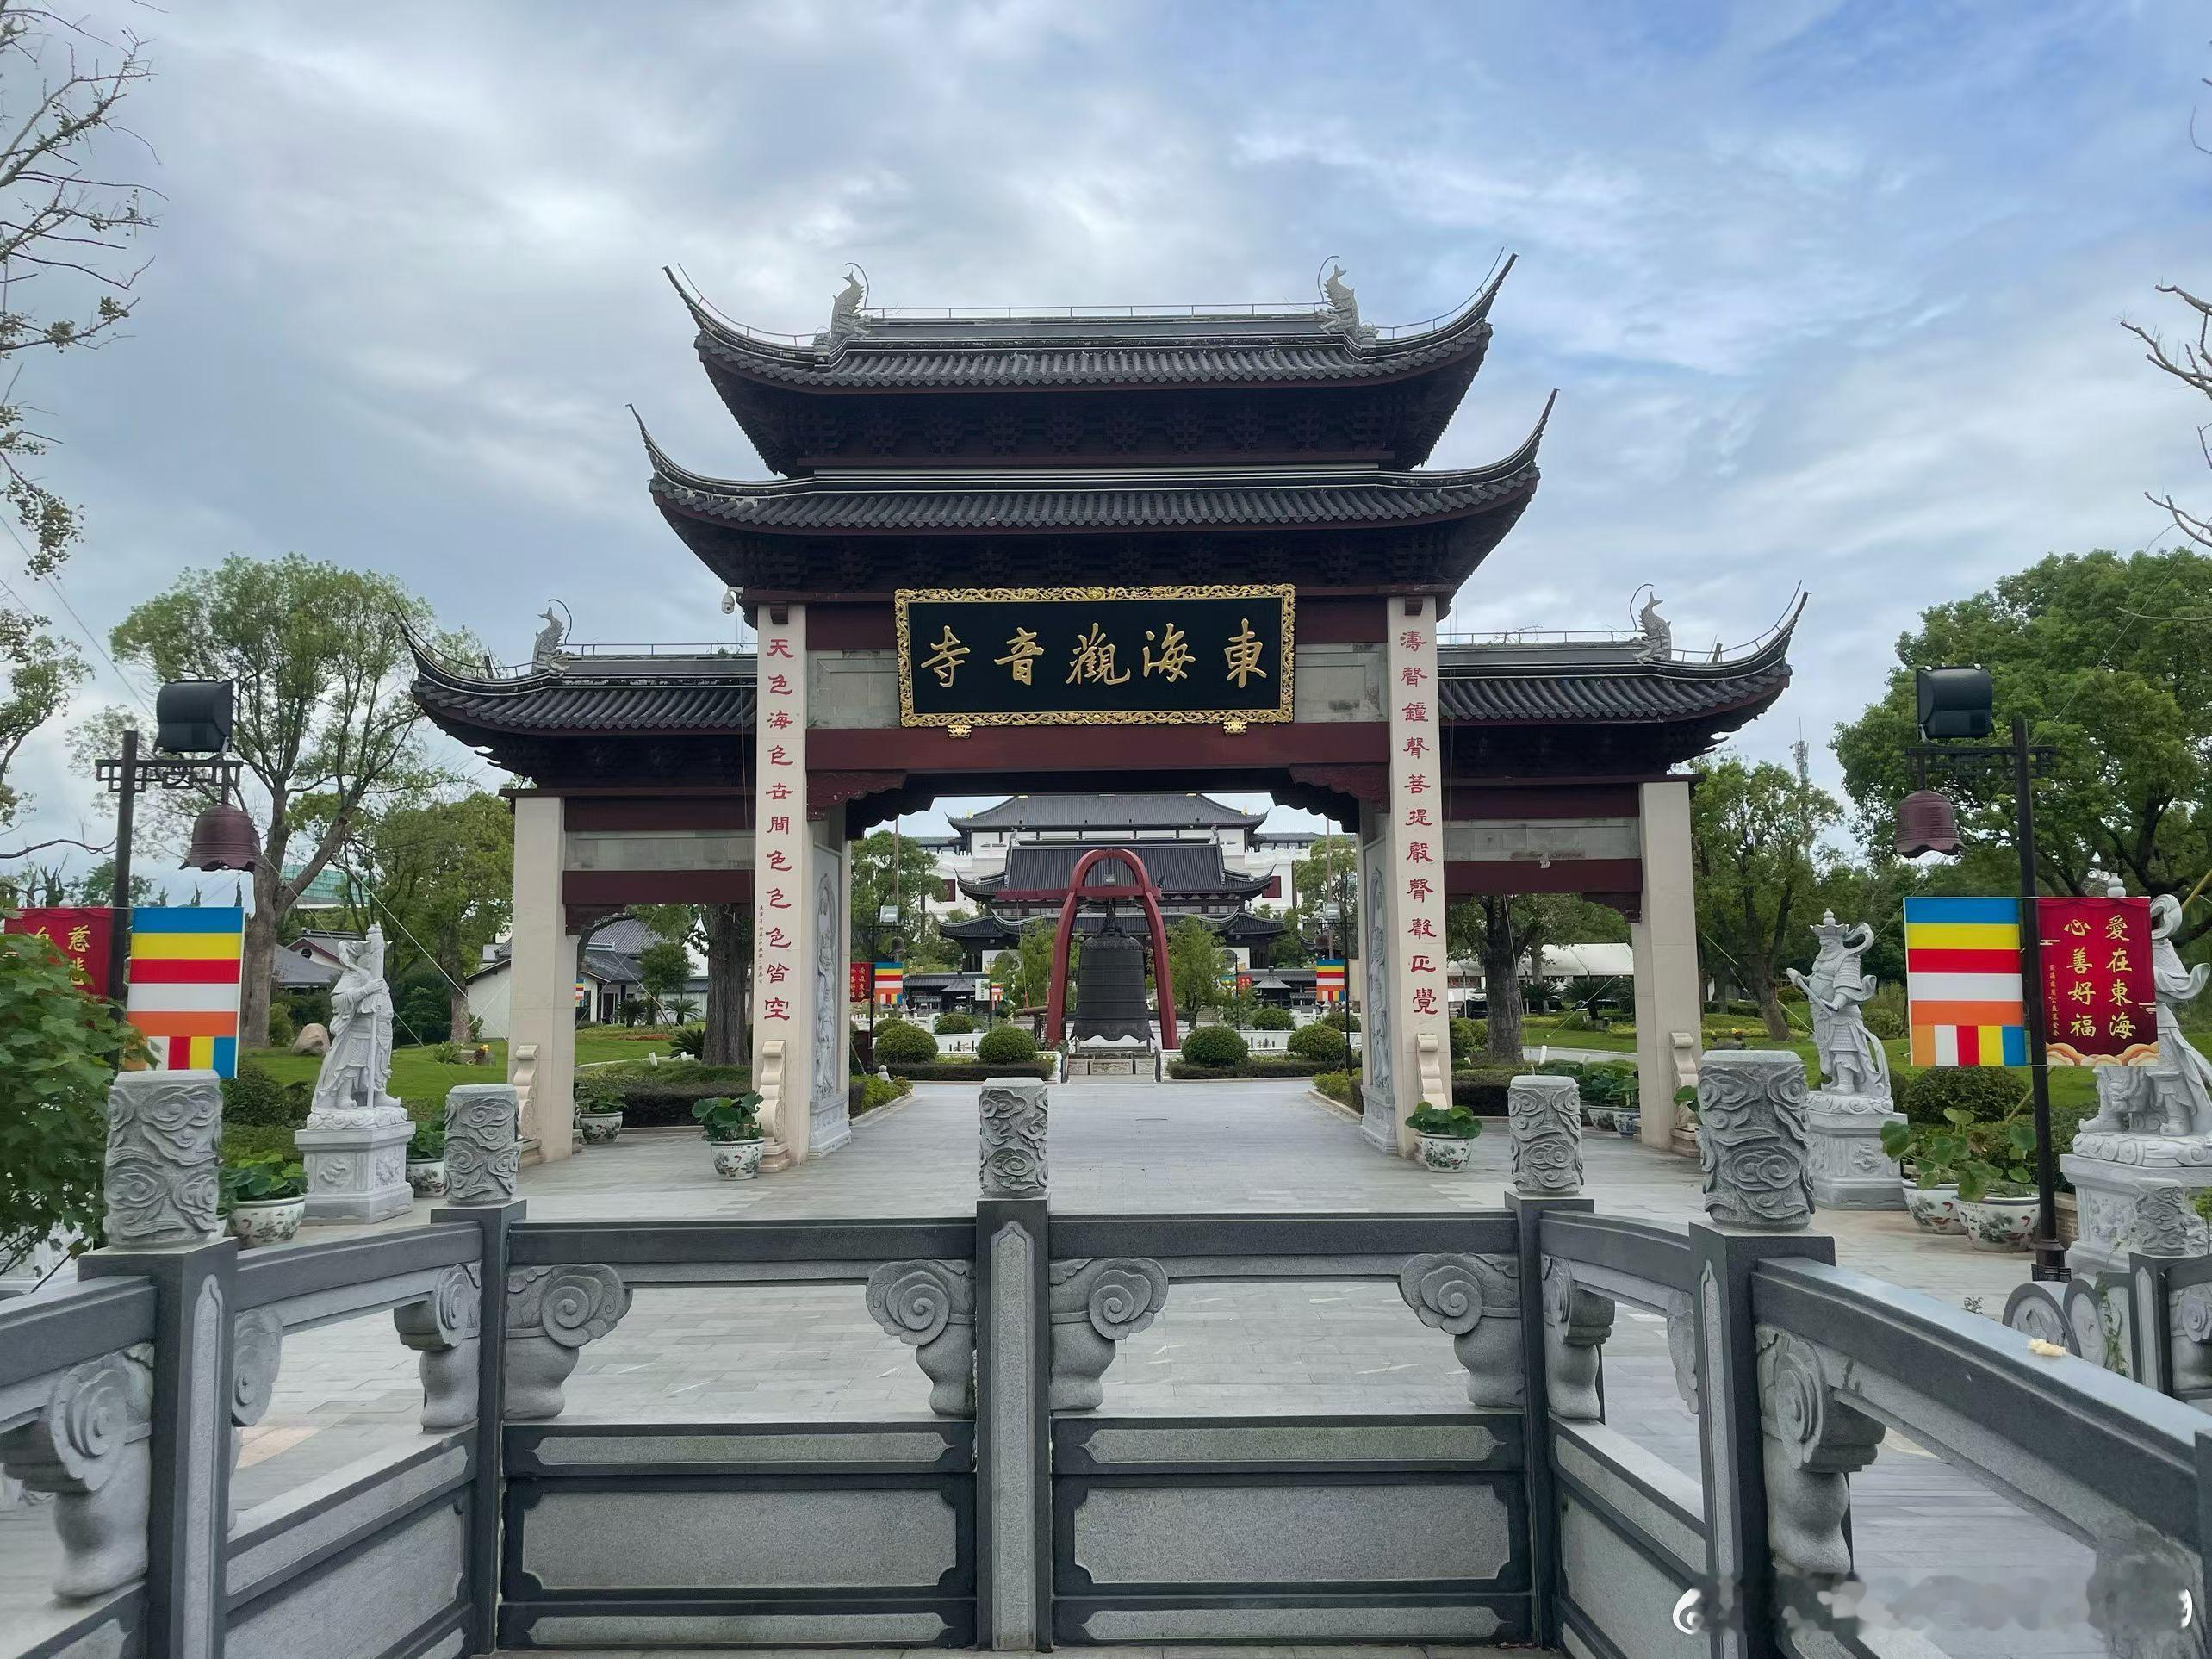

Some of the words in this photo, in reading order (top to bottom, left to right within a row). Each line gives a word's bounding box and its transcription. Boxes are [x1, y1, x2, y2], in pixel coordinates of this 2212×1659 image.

[920, 618, 1268, 688] 東海觀音寺
[2063, 918, 2097, 1038] 心善好福
[2104, 914, 2136, 1040] 愛在東海
